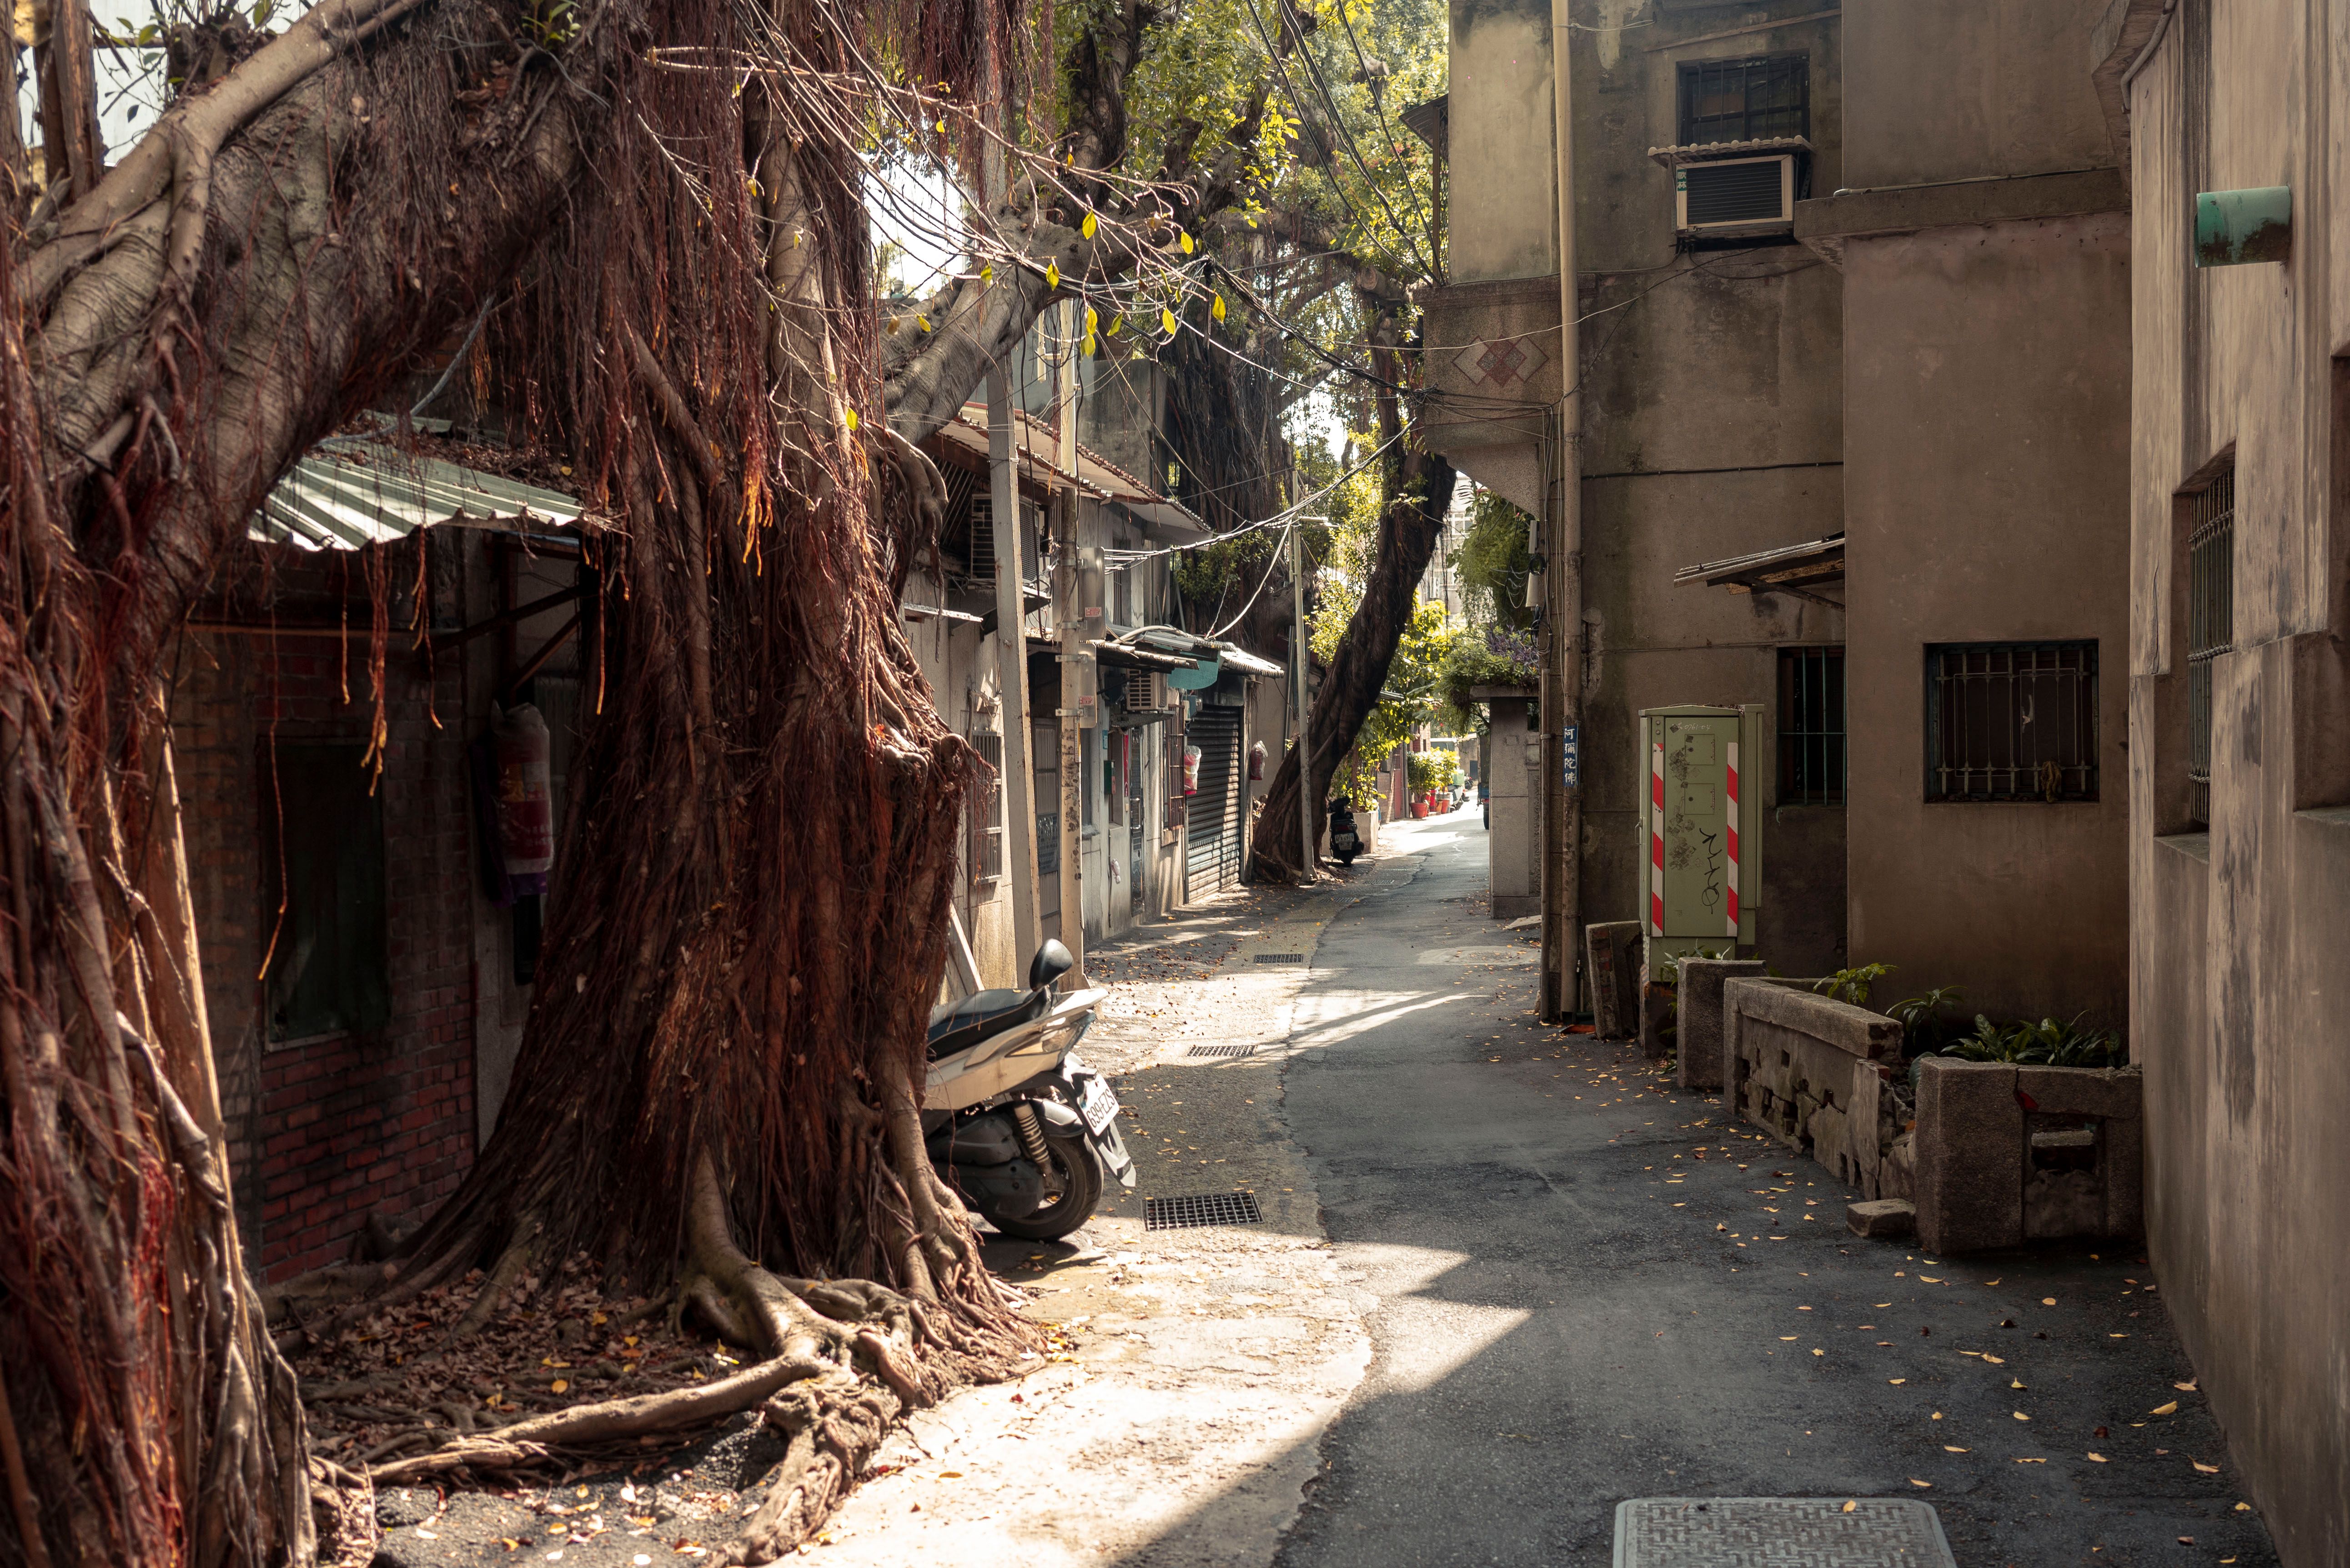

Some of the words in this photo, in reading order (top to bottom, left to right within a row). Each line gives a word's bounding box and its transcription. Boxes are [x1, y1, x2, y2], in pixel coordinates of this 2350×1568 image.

[1564, 728, 1576, 785] 阿彌陀佛
[1086, 1088, 1115, 1128] 699-EZS
